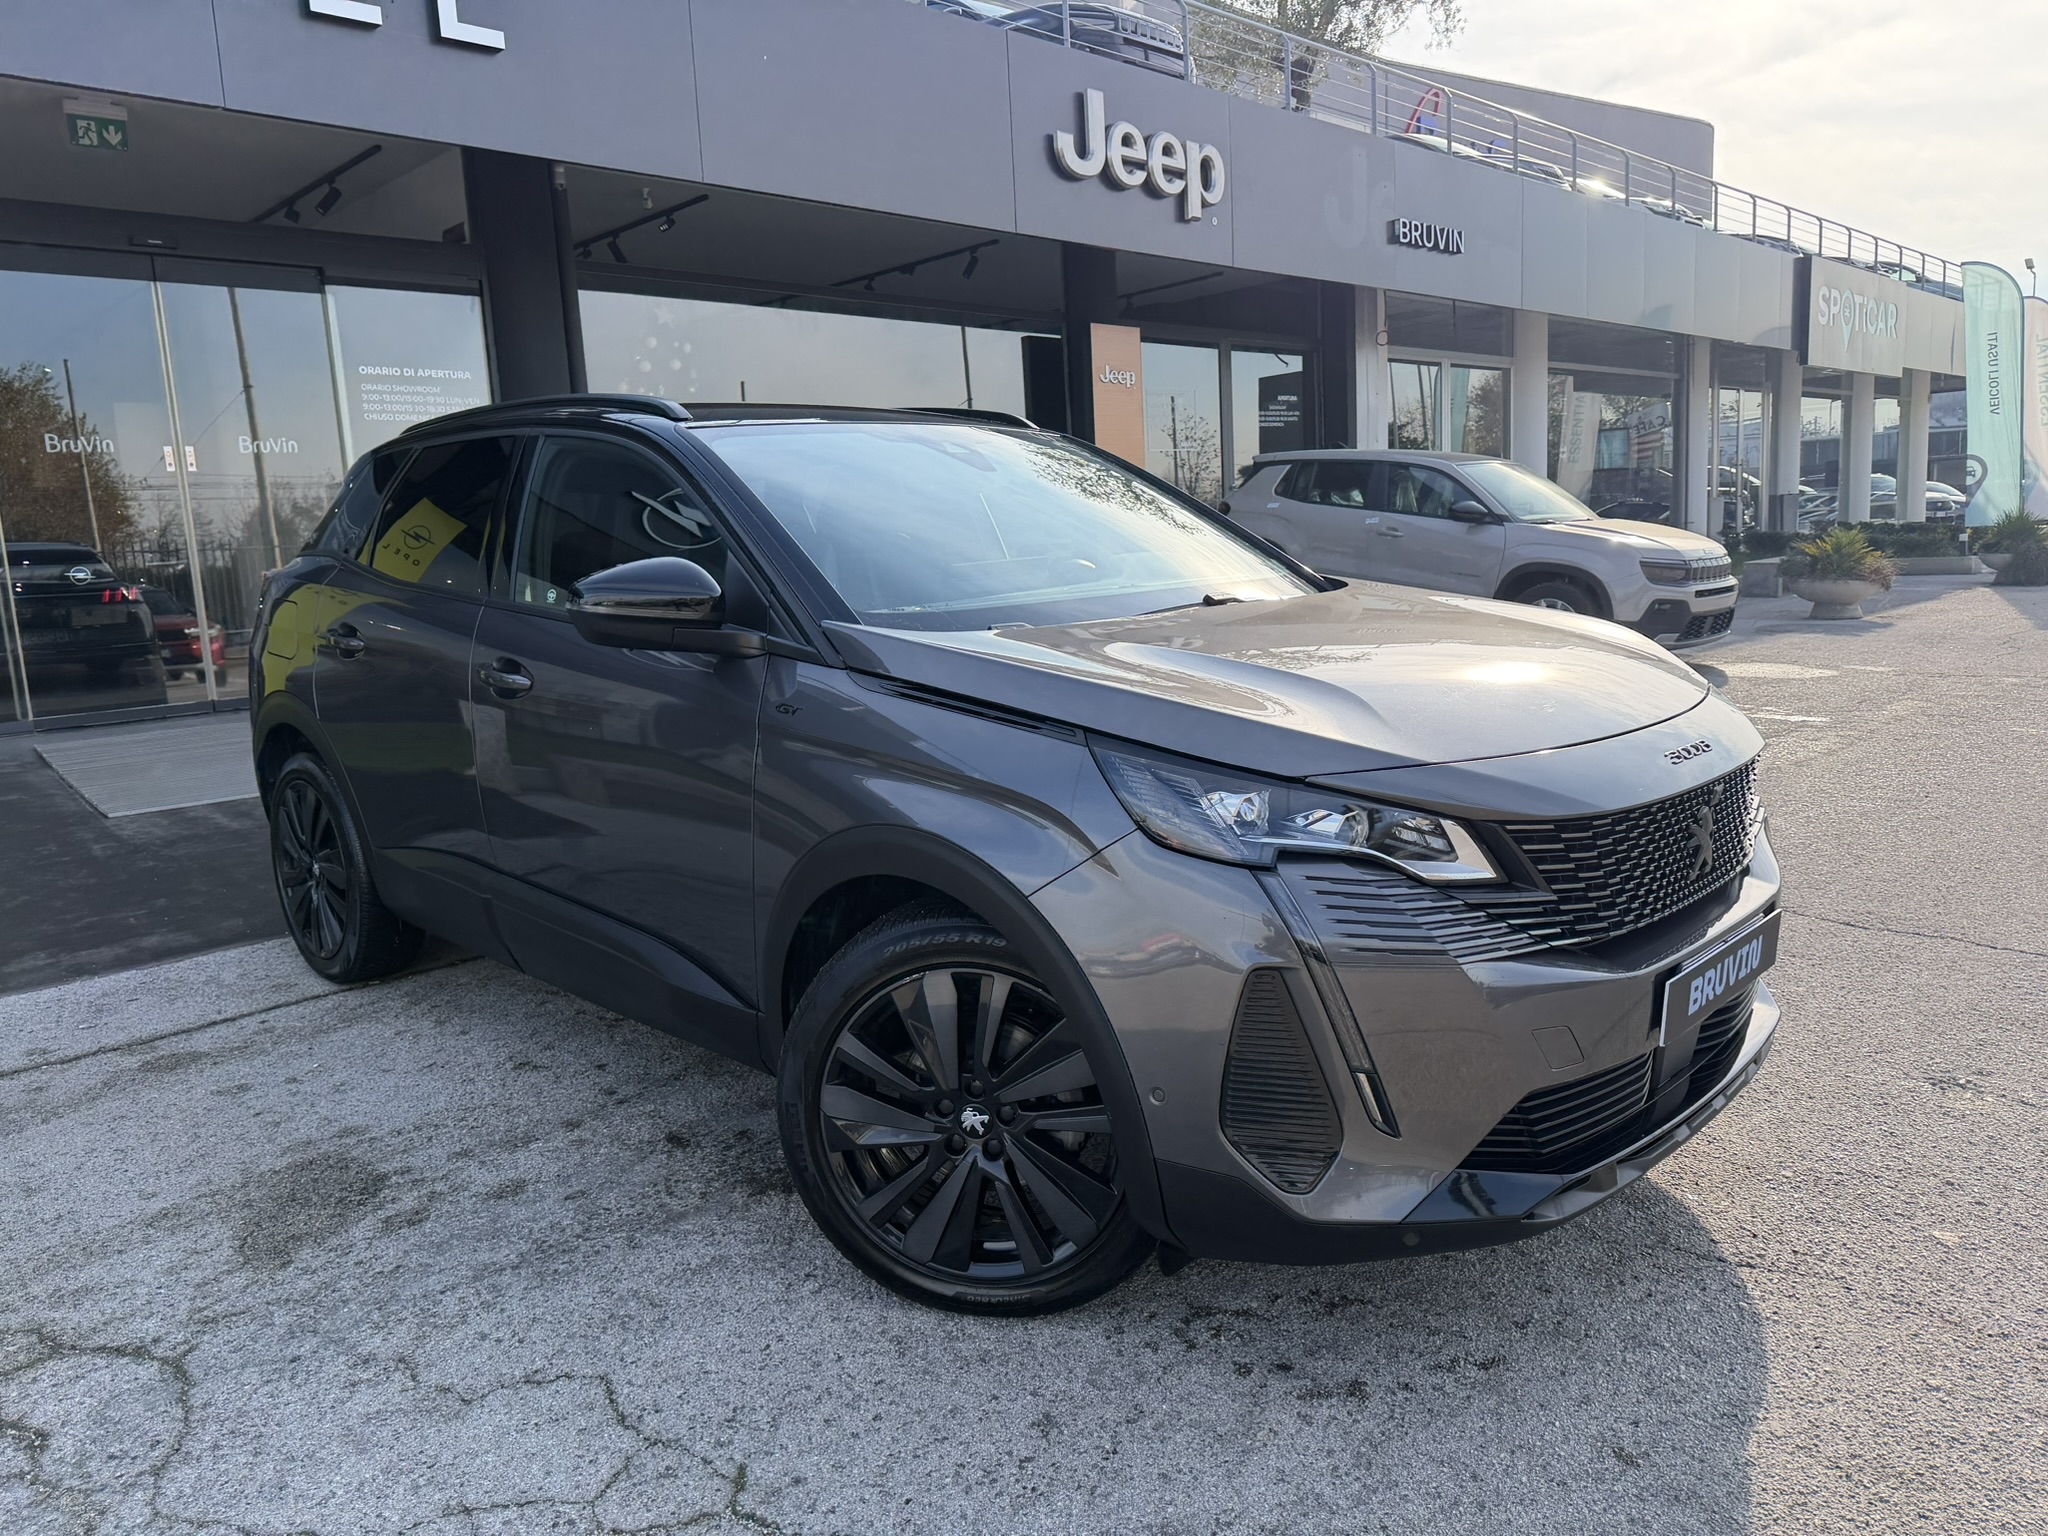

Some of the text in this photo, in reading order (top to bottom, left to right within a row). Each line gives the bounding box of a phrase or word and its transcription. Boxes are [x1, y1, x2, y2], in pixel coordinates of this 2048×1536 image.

[1053, 87, 1226, 222] Jeep
[1399, 217, 1465, 254] BRUVIN
[358, 365, 472, 380] ORARIO DI APERTURA
[1099, 364, 1136, 389] Jeep
[360, 383, 441, 394] ORARIO SHOWROOM
[44, 433, 115, 454] BruVin
[238, 435, 299, 454] BruVin
[1664, 739, 1713, 765] 3008
[882, 932, 961, 960] 205/55
[1687, 934, 1764, 1016] BRUVIN
